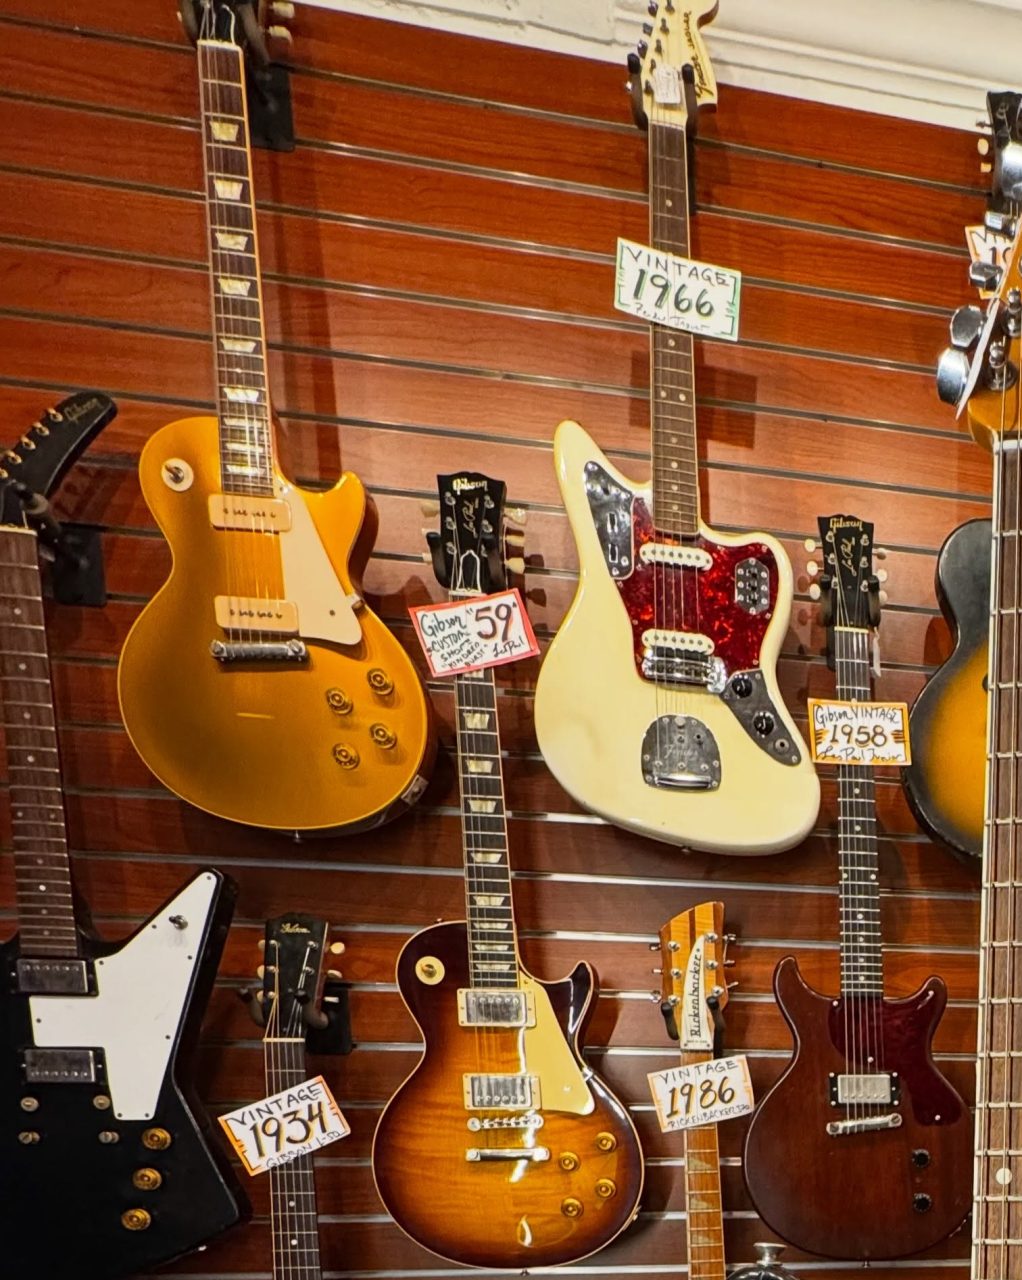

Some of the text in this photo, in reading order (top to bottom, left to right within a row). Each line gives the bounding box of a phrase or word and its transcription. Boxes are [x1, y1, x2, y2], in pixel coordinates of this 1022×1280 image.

[626, 245, 730, 287] VINTAGE
[632, 267, 715, 317] 1966
[452, 477, 488, 496] Gibson
[829, 516, 863, 534] Gibson
[420, 612, 467, 638] Gibson
[850, 705, 900, 724] VINTAGE
[829, 723, 888, 748] 1958
[687, 952, 702, 1039] Rickenbacker
[659, 1060, 739, 1085] VINTAGE
[229, 1084, 323, 1127] VINTAGE
[665, 1075, 736, 1120] 1986
[249, 1100, 328, 1159] 1934
